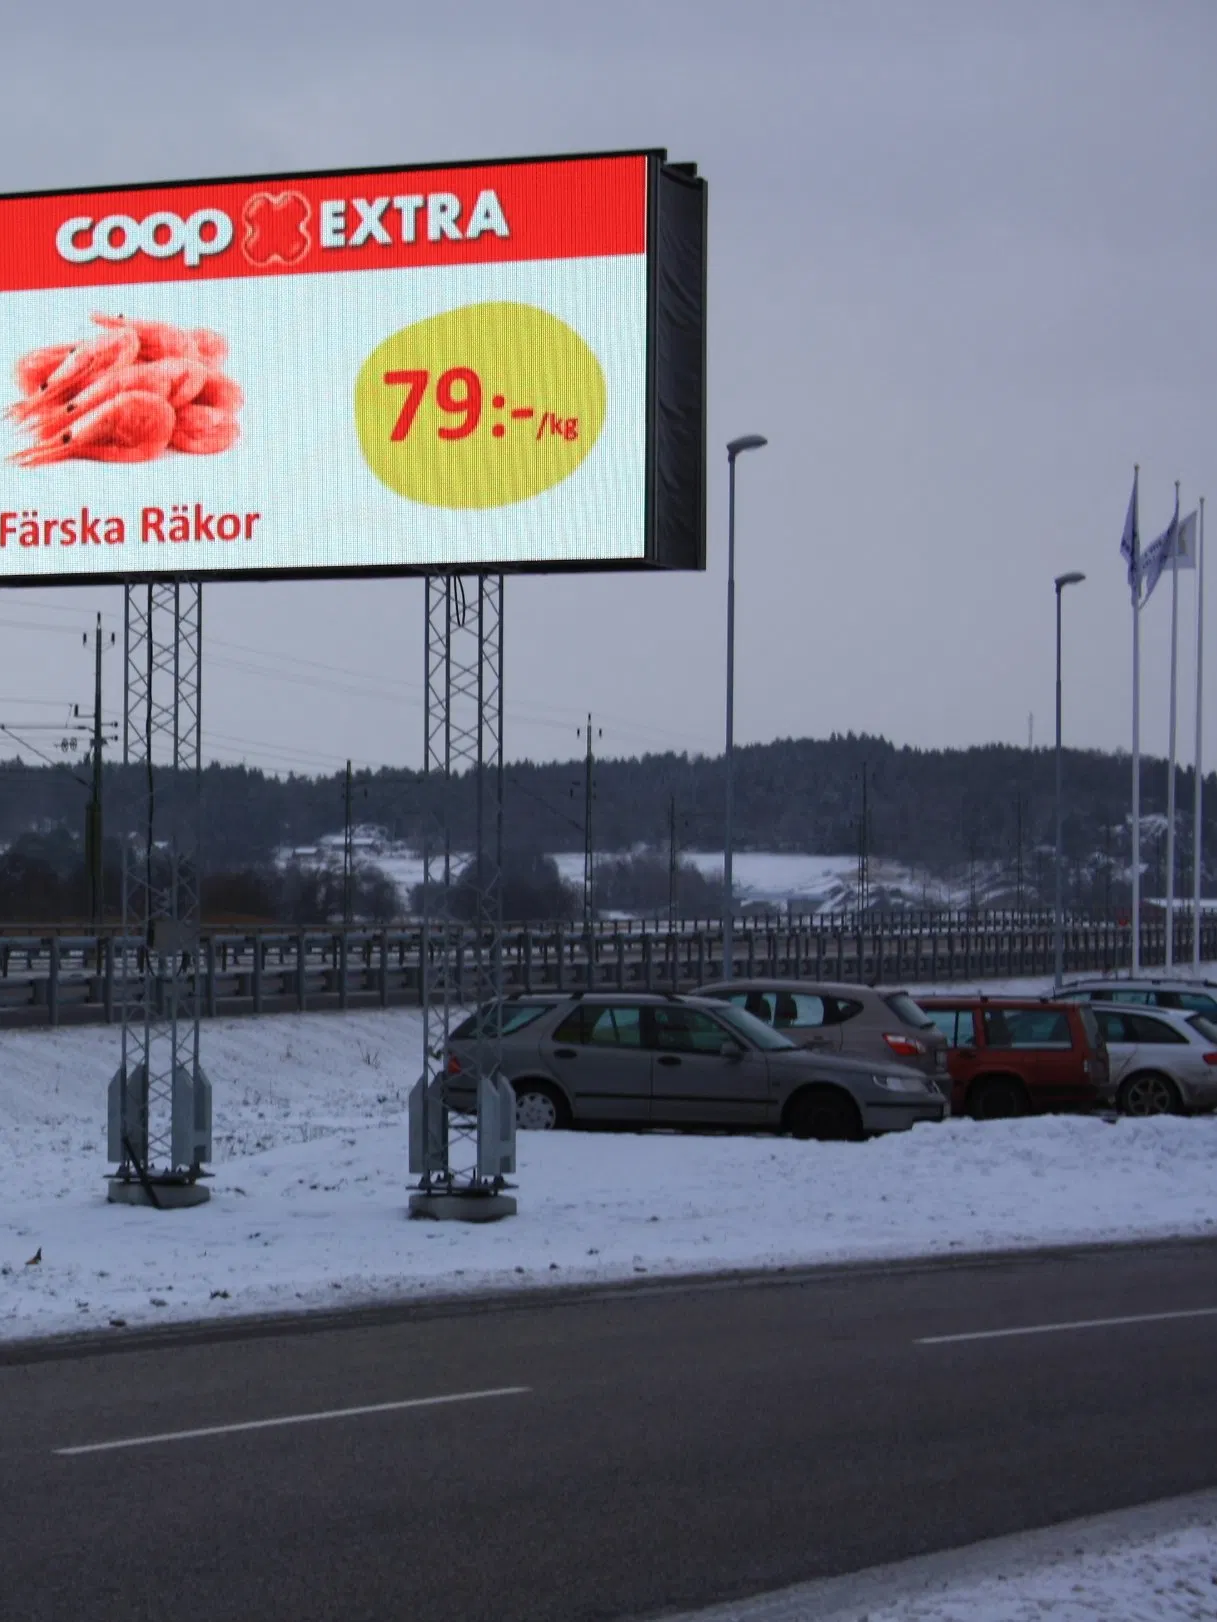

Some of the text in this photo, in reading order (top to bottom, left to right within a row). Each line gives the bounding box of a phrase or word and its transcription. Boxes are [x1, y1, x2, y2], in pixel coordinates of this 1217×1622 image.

[55, 189, 510, 266] coop EXTRA
[0, 503, 261, 547] Färska Räkor
